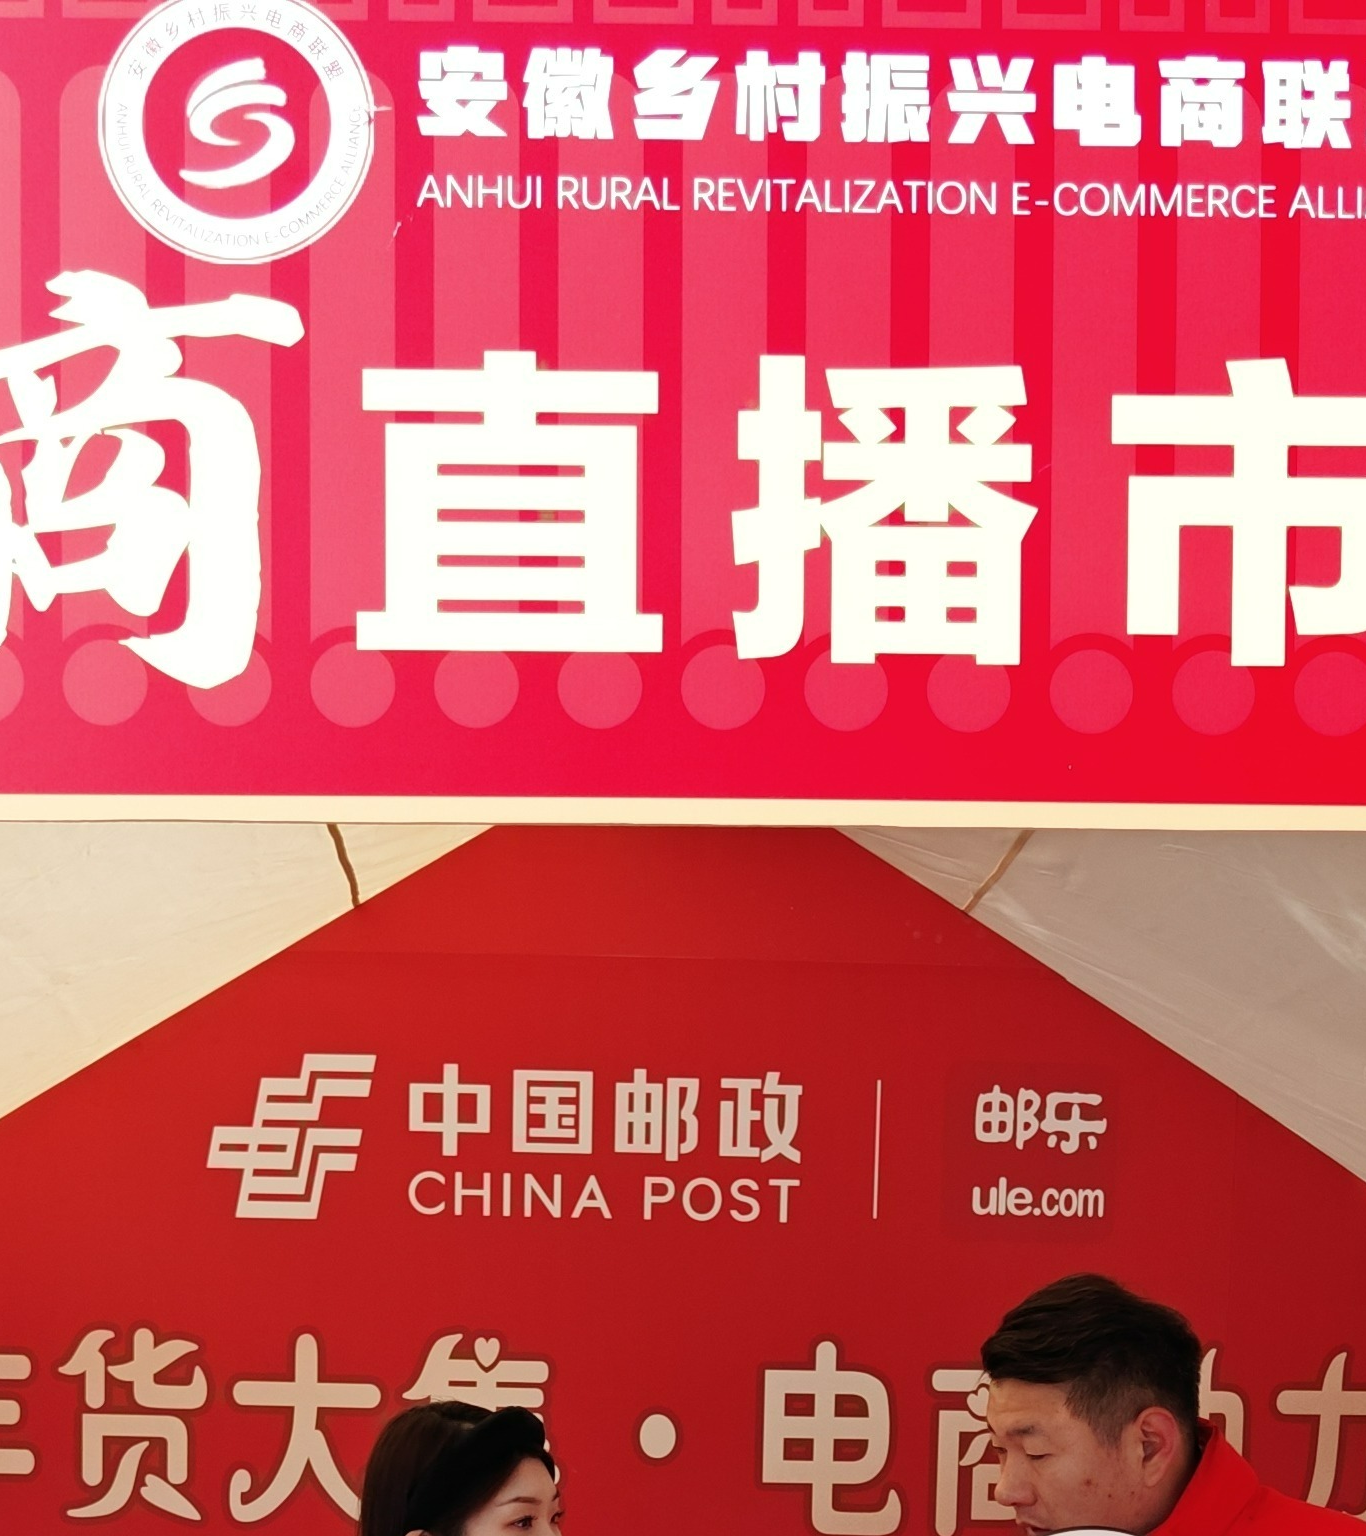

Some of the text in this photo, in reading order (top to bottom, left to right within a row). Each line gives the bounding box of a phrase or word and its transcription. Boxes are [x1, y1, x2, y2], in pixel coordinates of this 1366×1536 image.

[416, 174, 542, 210] ANHUI
[557, 175, 680, 211] RURAL
[693, 177, 997, 215] REVITALIZATION
[1012, 181, 1276, 218] E-COMMERCE
[407, 1062, 804, 1164] 中国邮政
[974, 1084, 1108, 1154] 邮乐
[407, 1170, 801, 1224] CHINA POST
[972, 1182, 1106, 1220] ule.com
